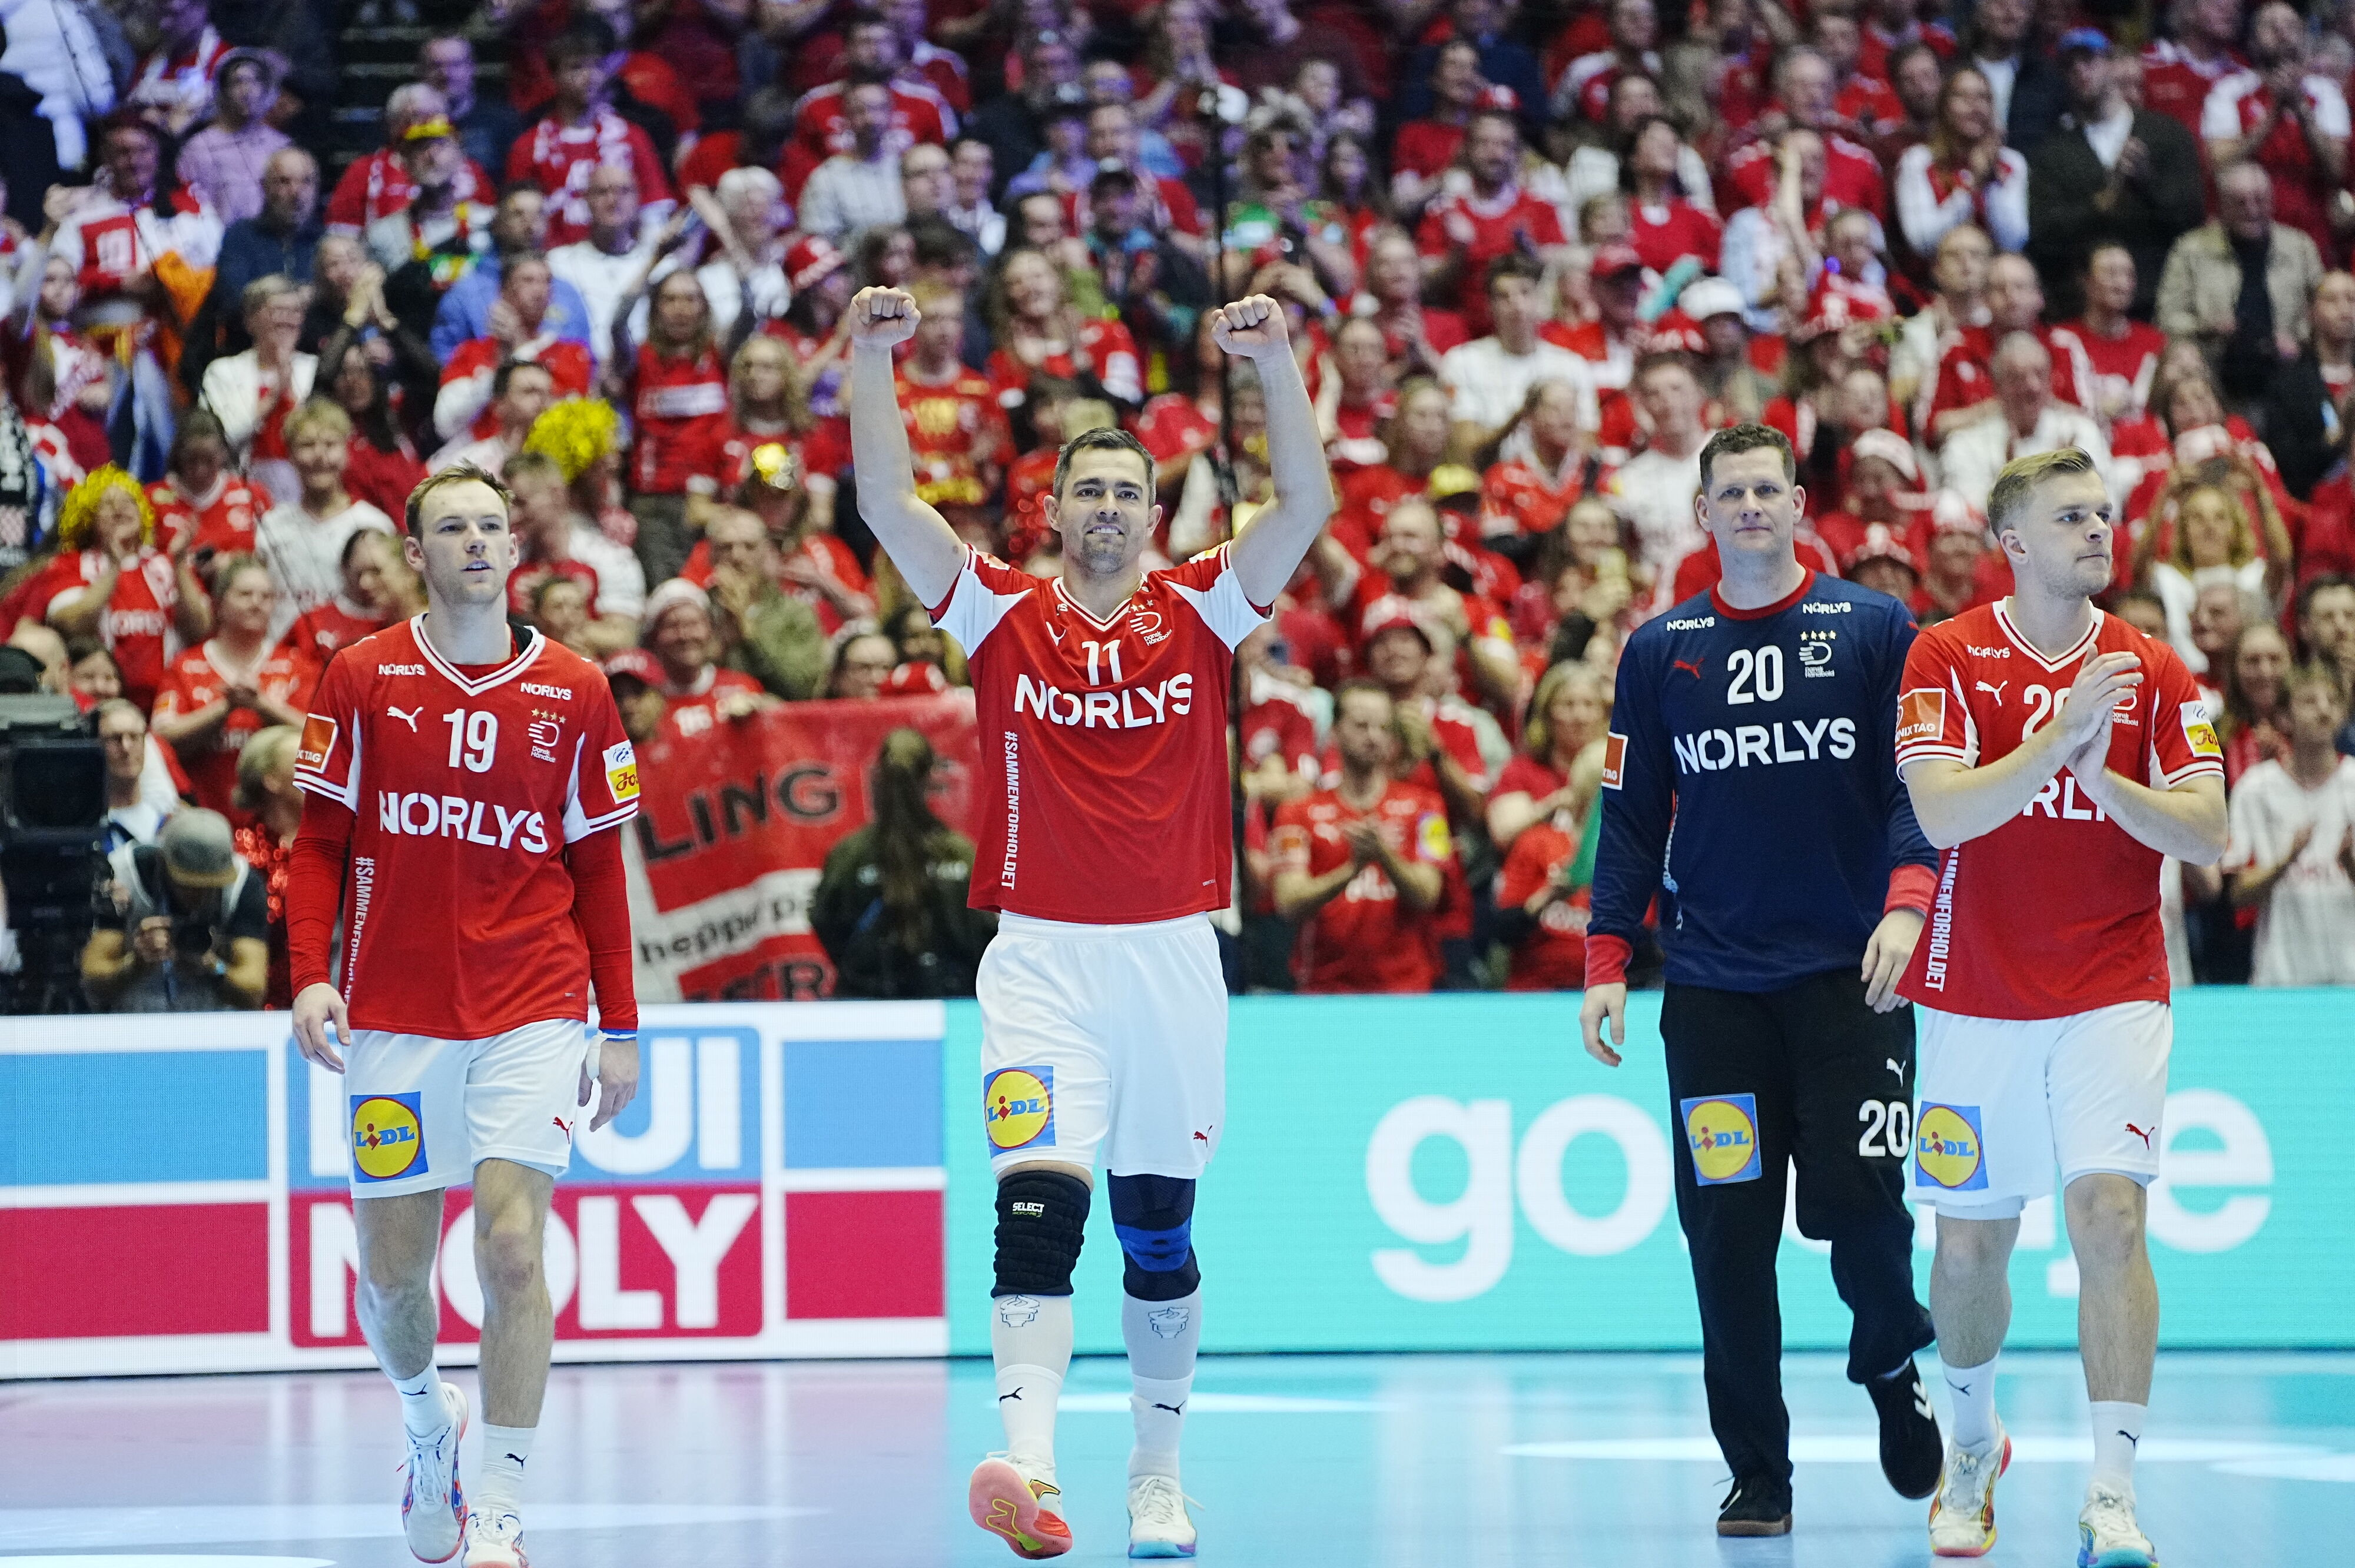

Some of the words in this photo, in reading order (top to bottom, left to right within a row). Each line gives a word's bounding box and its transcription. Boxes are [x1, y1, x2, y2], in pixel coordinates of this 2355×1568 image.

[1667, 616, 1715, 631] NORLYS
[1802, 602, 1852, 614] NORLYS
[378, 663, 426, 676] NORLYS
[1082, 639, 1123, 686] 11
[1727, 645, 1784, 705] 20
[520, 682, 572, 701] NORLYS
[1014, 672, 1193, 729] NORLYS
[442, 708, 499, 773] 19
[1674, 717, 1856, 775] NORLYS
[1913, 722, 1936, 733] TAG
[304, 750, 321, 763] TAG
[378, 790, 549, 853] NORLYS
[1001, 730, 1020, 891] #SAMMENFORHOLDET
[1859, 1099, 1910, 1158] 20
[1012, 1202, 1045, 1213] SELECT
